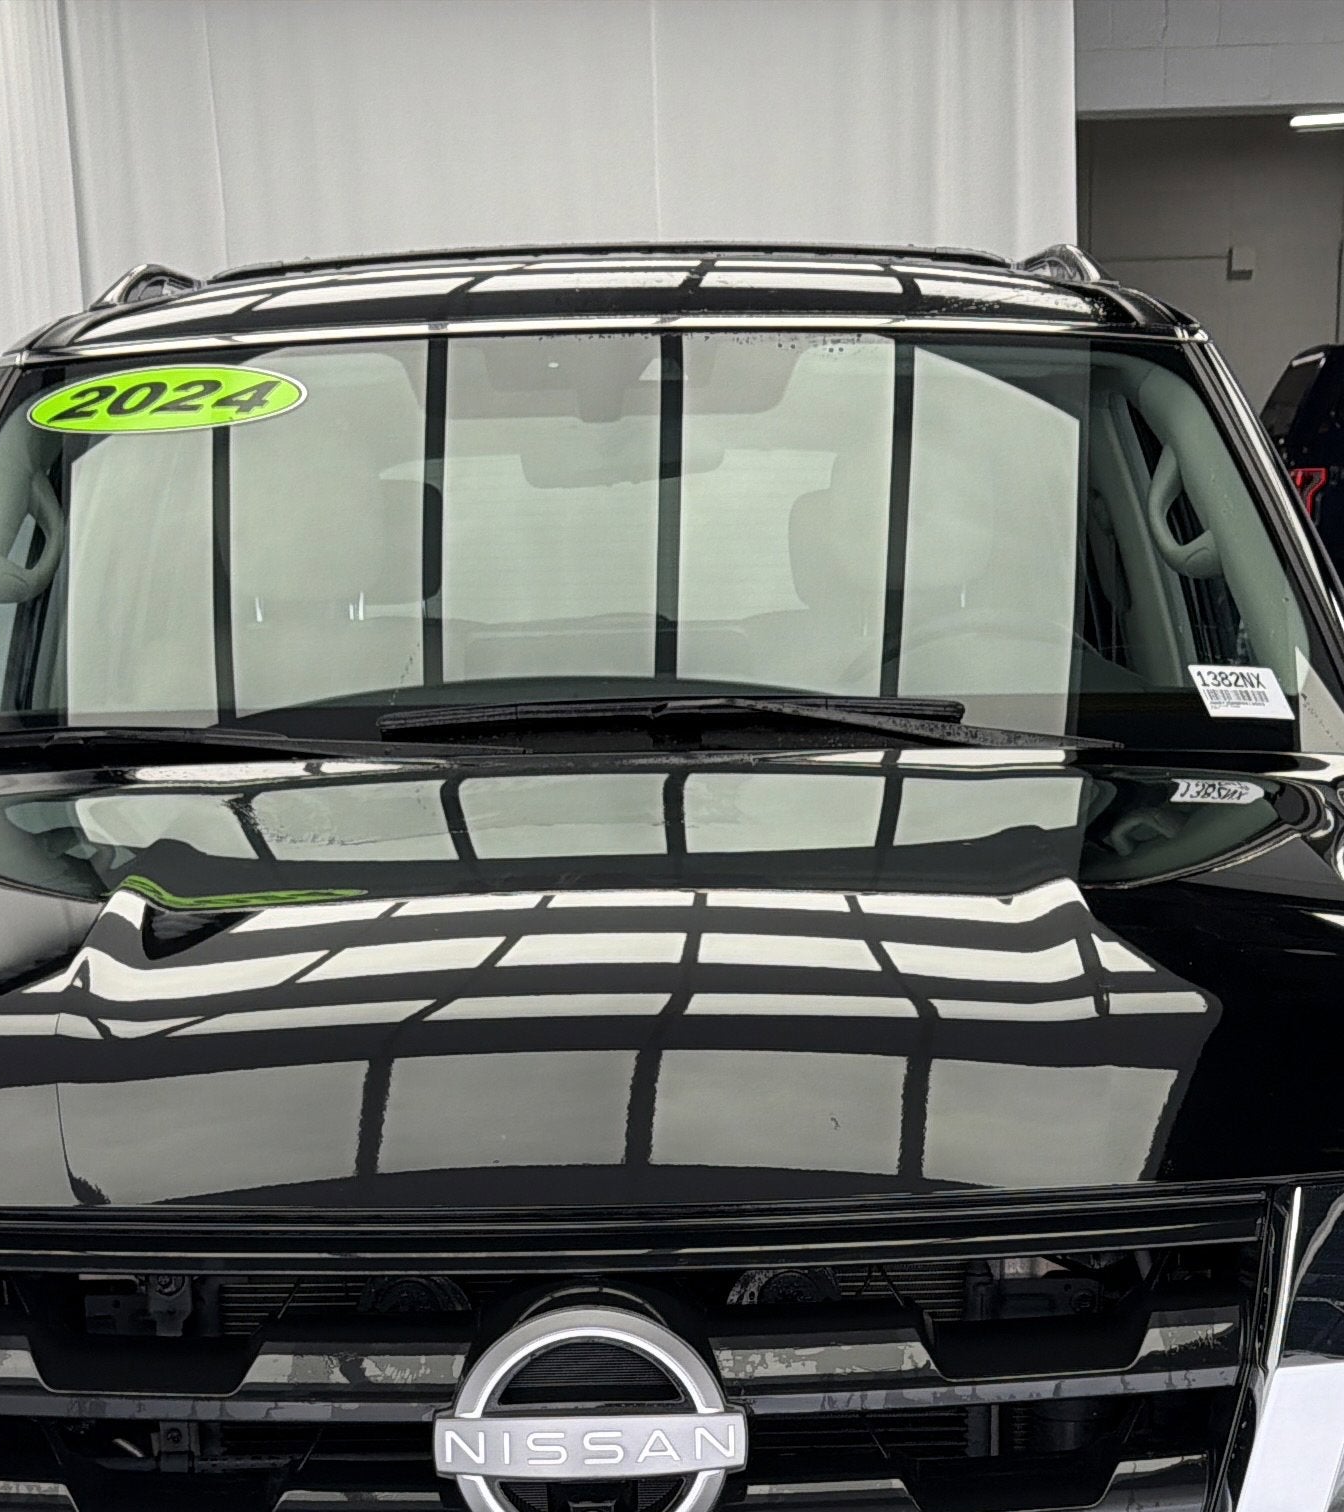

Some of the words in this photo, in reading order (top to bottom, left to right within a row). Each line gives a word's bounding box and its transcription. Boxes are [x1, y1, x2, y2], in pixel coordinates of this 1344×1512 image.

[47, 380, 282, 423] 2024
[1196, 670, 1267, 689] 1382NX
[445, 1424, 735, 1465] NISSAN
